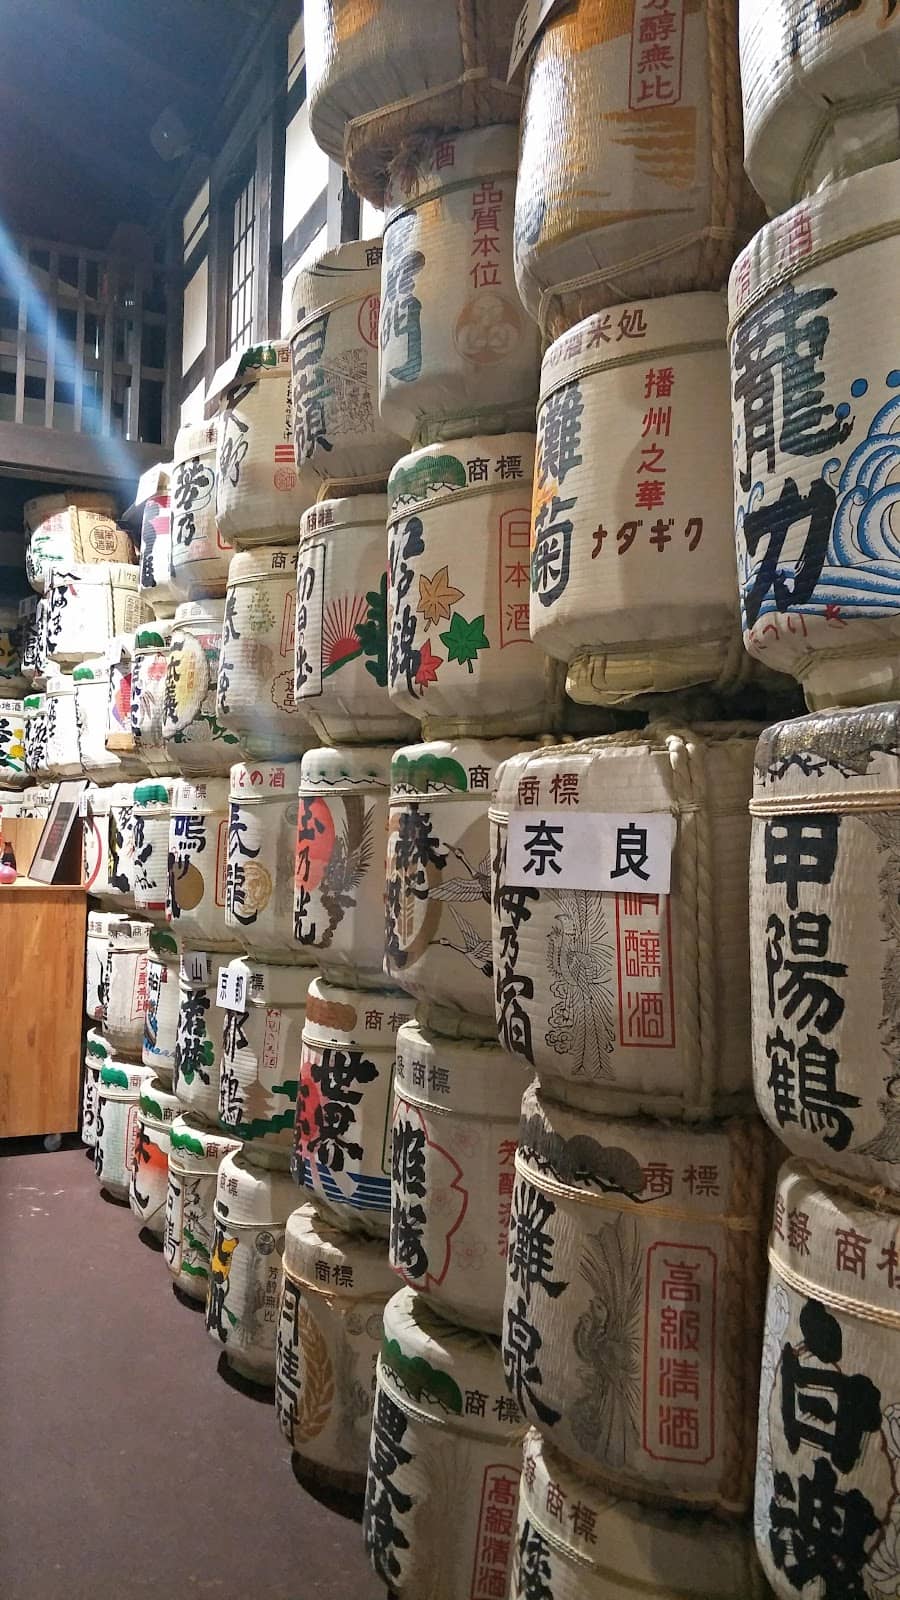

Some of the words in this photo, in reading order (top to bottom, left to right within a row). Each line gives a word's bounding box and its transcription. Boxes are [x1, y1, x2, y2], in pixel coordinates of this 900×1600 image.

[637, 0, 676, 102] 醇無比
[470, 181, 503, 288] 品質本位
[466, 455, 524, 482] 商標
[635, 367, 675, 511] 播州之華
[531, 378, 585, 607] 灘菊
[591, 517, 703, 560] ナダギク
[505, 521, 532, 632] 日本酒
[0, 701, 22, 712] 地酒
[468, 765, 492, 789] 商
[517, 773, 580, 807] 商標
[522, 819, 651, 881] 奈良
[764, 815, 862, 1142] 甲陽鶴
[412, 1060, 450, 1094] 商標
[640, 1162, 720, 1198] 商標
[314, 1260, 354, 1288] 商標
[505, 1185, 568, 1427] 灘泉
[658, 1258, 701, 1452] 高級清酒
[464, 1390, 523, 1424] 商標
[478, 1475, 518, 1599] 高級清酒
[546, 1480, 599, 1545] 商標
